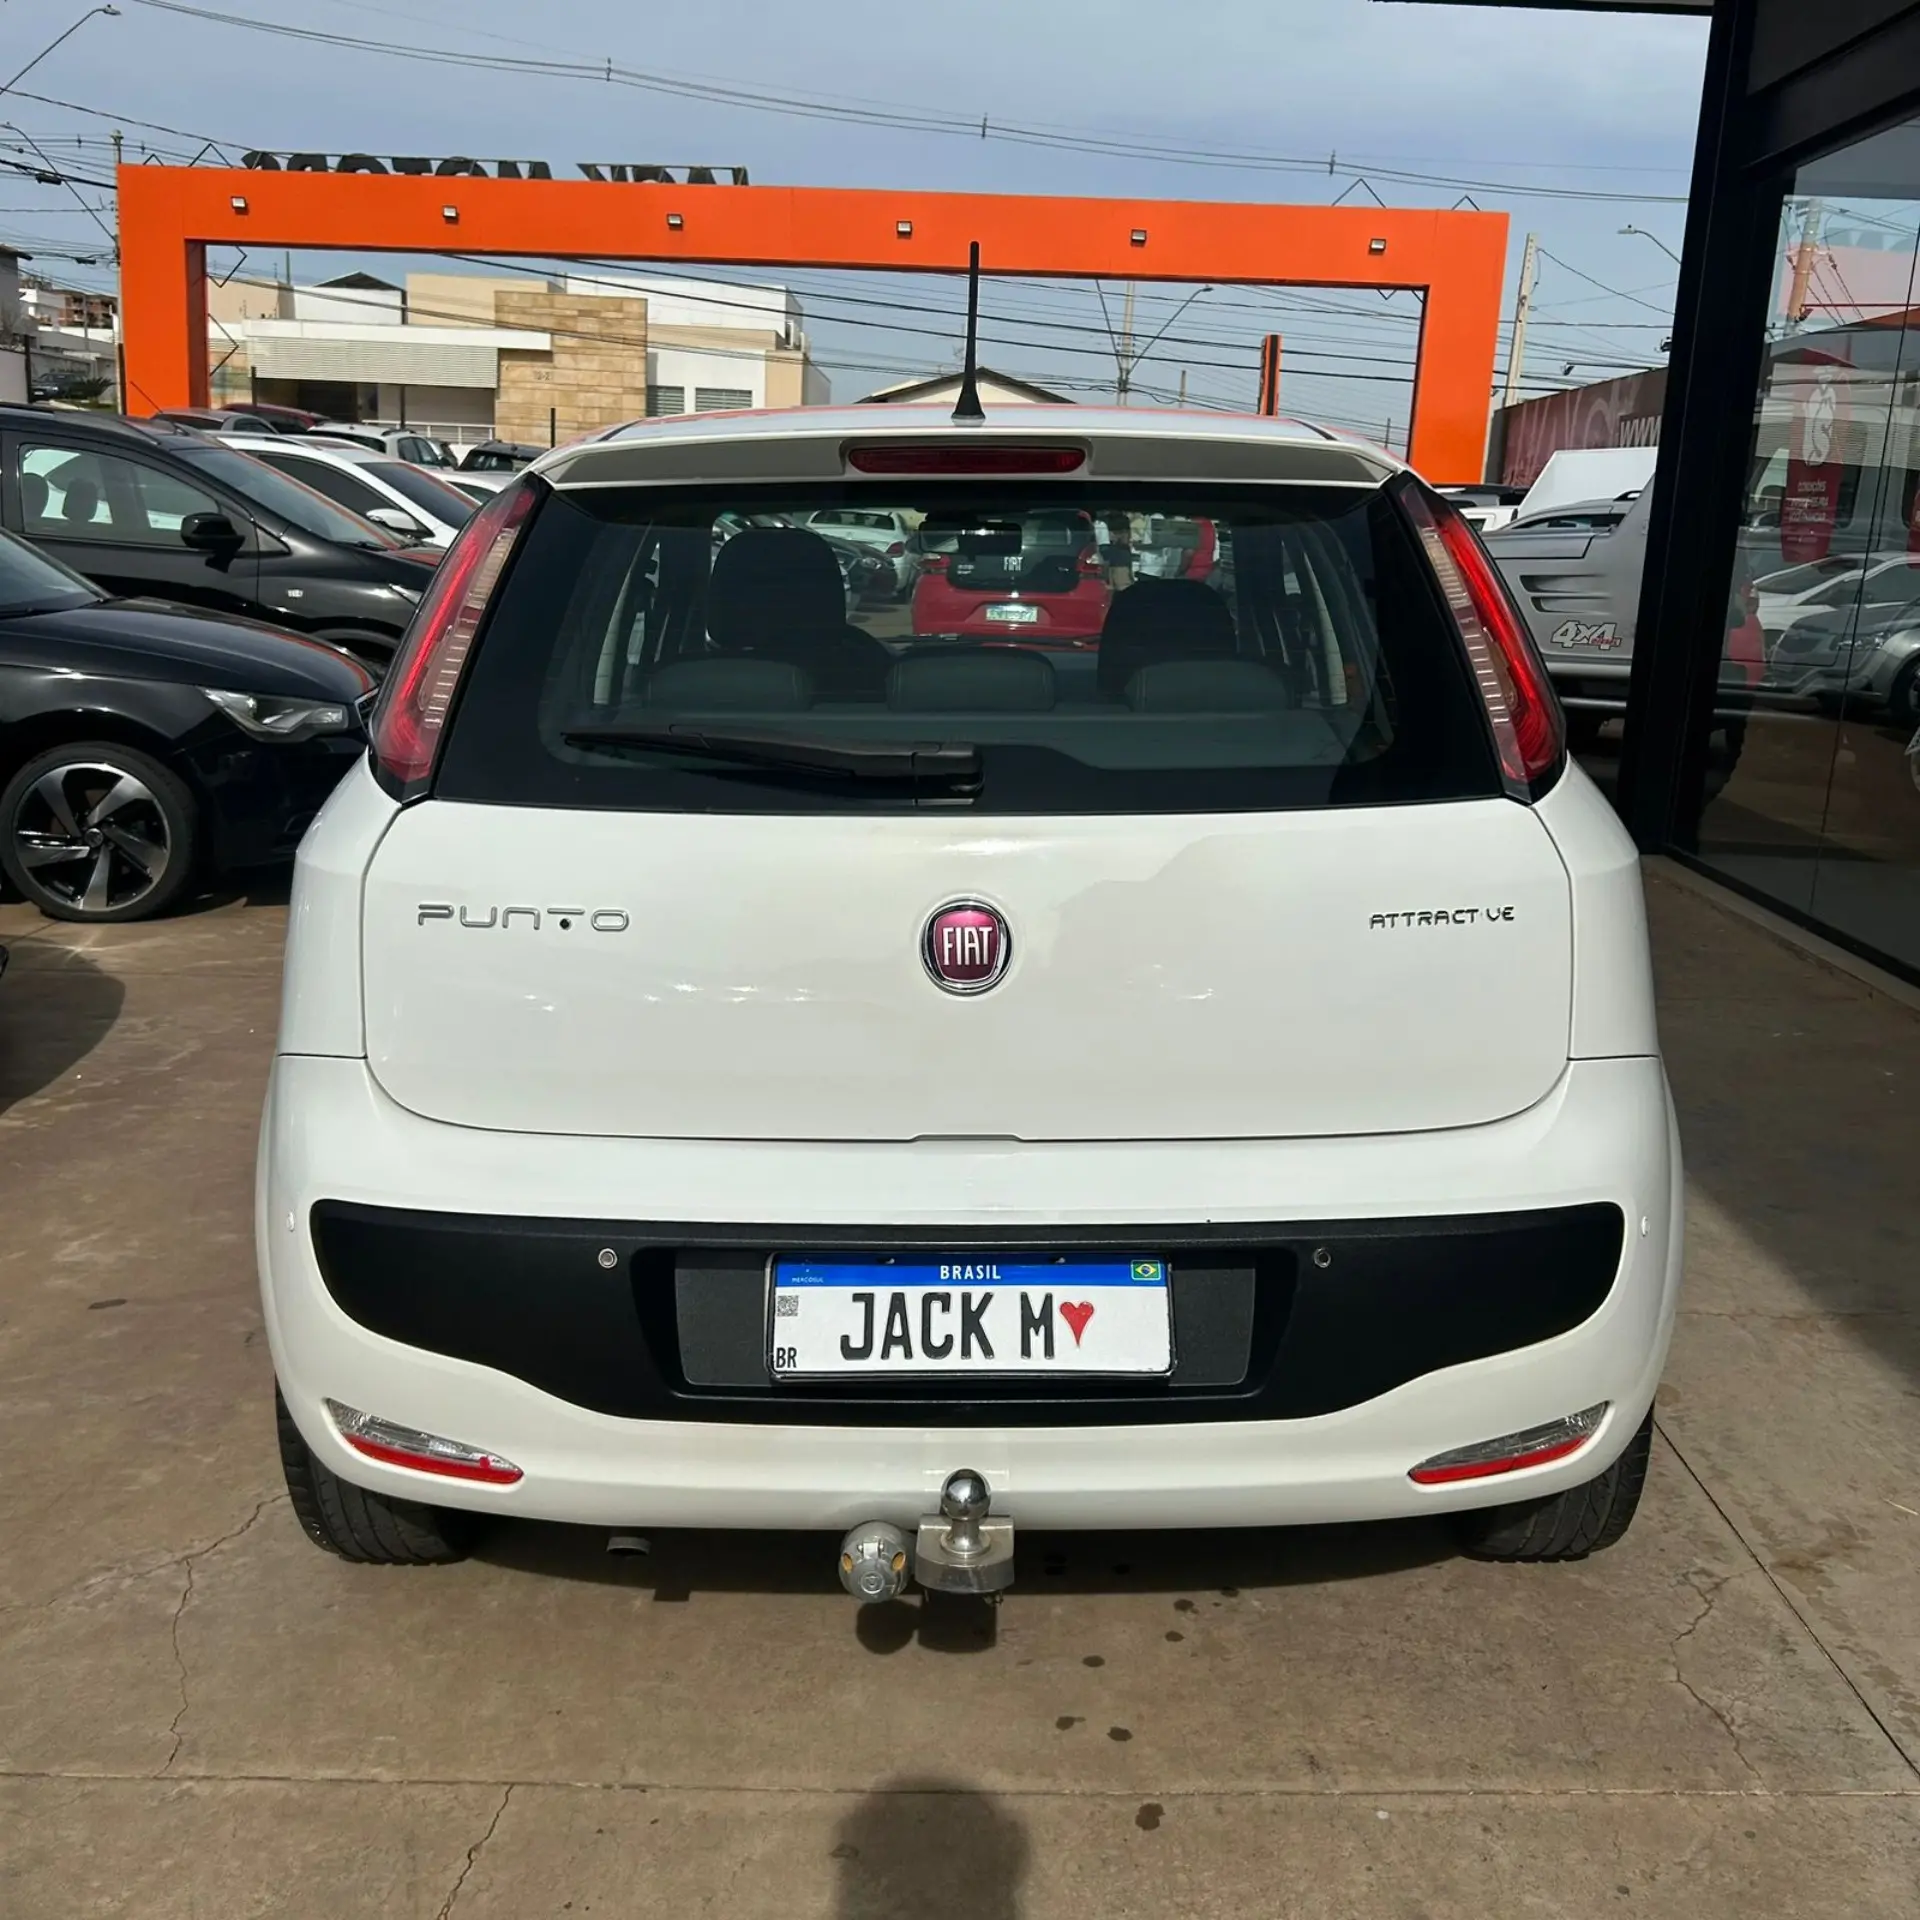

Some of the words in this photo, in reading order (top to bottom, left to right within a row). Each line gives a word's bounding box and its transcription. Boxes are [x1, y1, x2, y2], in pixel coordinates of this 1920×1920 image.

[418, 904, 630, 932] PUNTO
[1369, 906, 1515, 930] ATTRACTVE
[943, 926, 993, 966] FIAT
[940, 1265, 1001, 1280] BRASIL
[840, 1292, 995, 1360] JACK
[1020, 1292, 1055, 1360] M
[776, 1347, 798, 1369] BR
